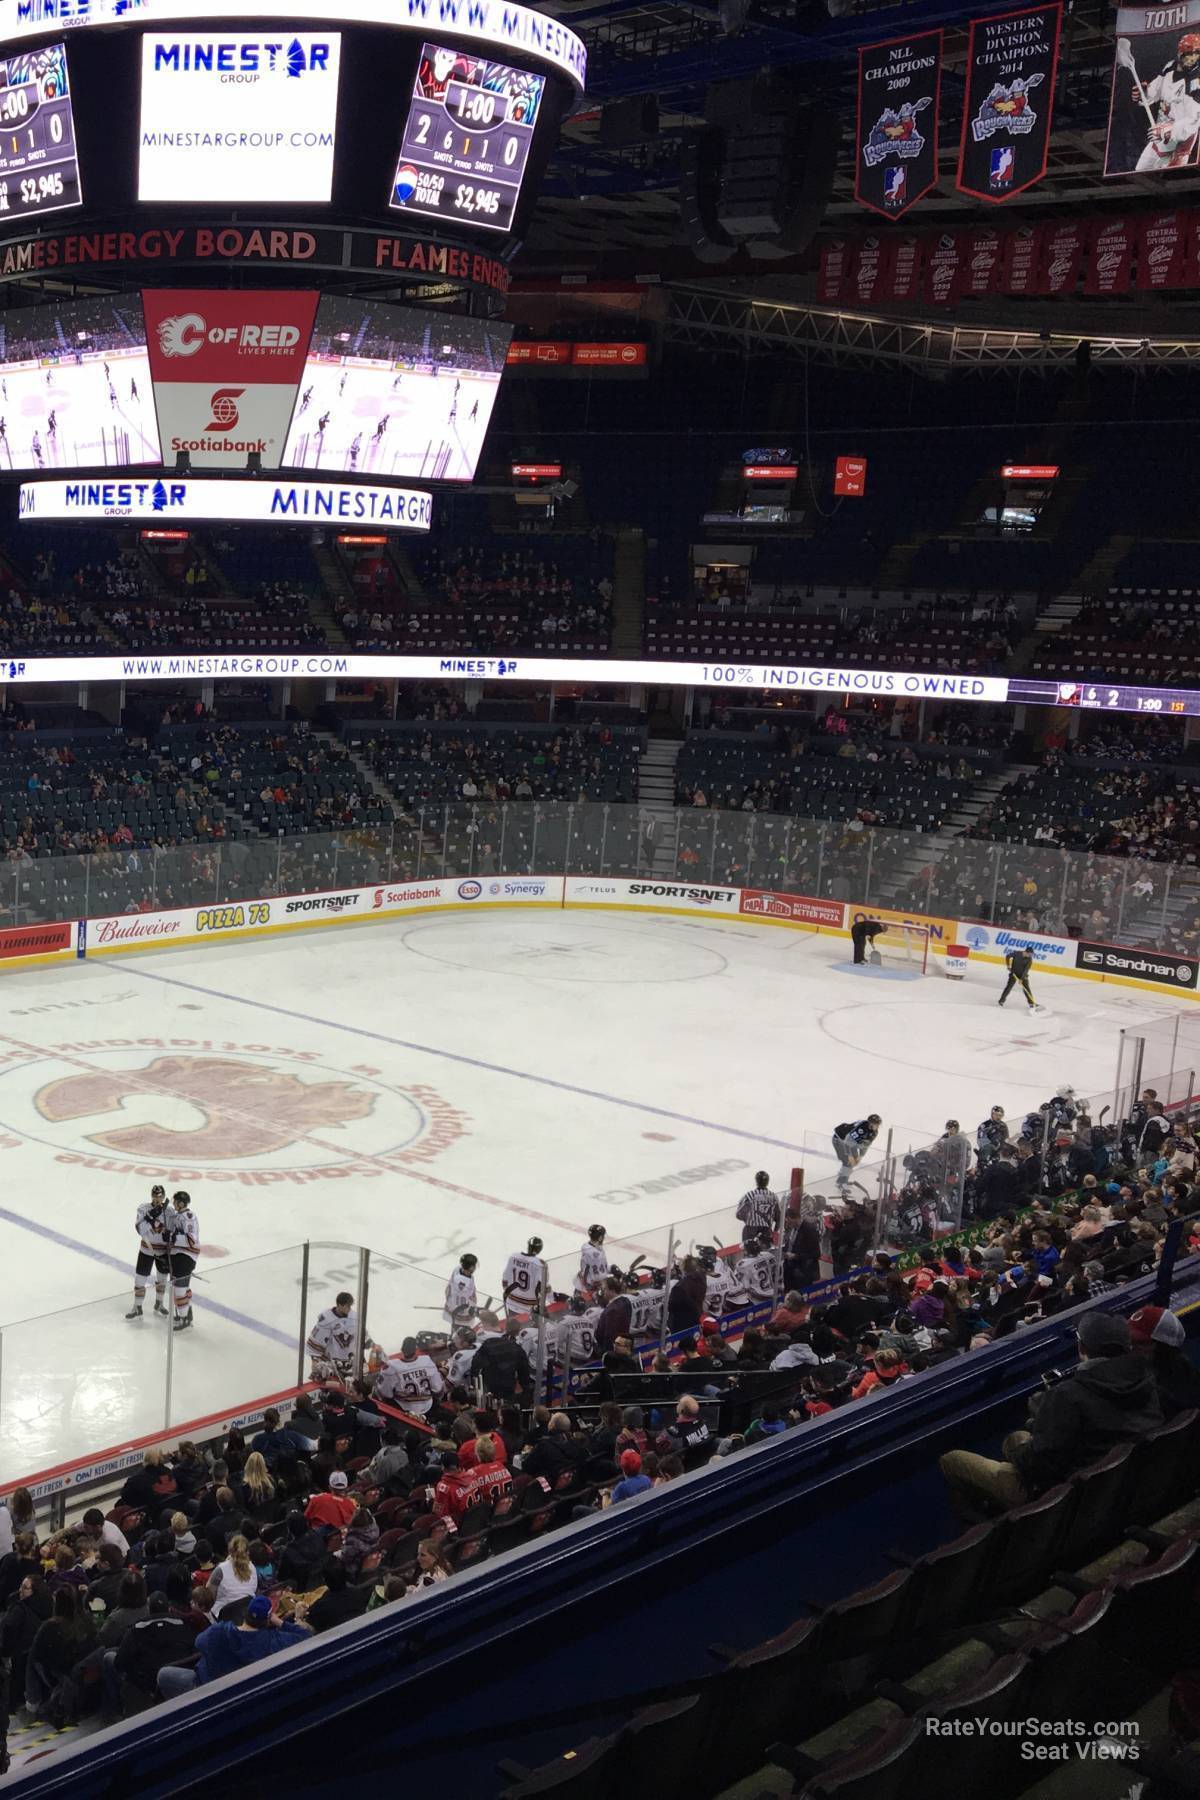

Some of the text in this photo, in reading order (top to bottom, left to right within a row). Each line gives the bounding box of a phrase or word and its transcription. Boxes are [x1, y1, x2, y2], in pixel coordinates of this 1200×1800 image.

[985, 16, 1045, 36] WESTERN
[1145, 6, 1187, 29] TOTH
[985, 30, 1043, 50] DIVISION
[154, 38, 330, 77] MINESTAR
[888, 47, 914, 61] NLL
[975, 42, 1050, 66] CHAMPIONS
[220, 74, 260, 83] GROUP
[864, 56, 936, 81] CHAMPIONS
[999, 61, 1024, 75] 2014
[886, 77, 911, 91] 2009
[457, 89, 495, 123] 1:00
[50, 113, 63, 143] 0
[142, 132, 333, 147] MINESTARGROUP.COM
[414, 114, 518, 165] 2 6 1 1 0
[27, 151, 47, 161] SHOTS
[433, 150, 453, 163] SHOTS
[474, 161, 493, 172] SHOTS
[20, 172, 64, 203] $2,945
[415, 187, 440, 206] TOTAL
[417, 172, 501, 214] 50/50 $2,945
[64, 230, 184, 263] ENERGY
[194, 229, 317, 260] BOARD
[375, 238, 469, 278] FLAMES
[208, 325, 301, 347] OF RED
[237, 347, 296, 356] LIVES HERE
[171, 437, 267, 452] Scotiabank
[65, 481, 187, 510] MINESTAR
[104, 507, 133, 516] GROUP
[122, 658, 348, 674] WWW.MINESTARGROUP.COM
[702, 666, 755, 683] 100%
[762, 669, 895, 690] INDIGENOUS
[904, 676, 986, 695] OWNED
[1088, 688, 1097, 699] 6
[1107, 689, 1119, 706] 2
[1137, 697, 1163, 710] 1:00
[1170, 702, 1186, 712] 1ST
[460, 885, 479, 894] Esso
[505, 883, 546, 895] Synergy
[629, 883, 736, 902] SPORTSNET
[96, 919, 180, 942] Budweiser
[196, 906, 244, 931] PIZZA
[249, 903, 270, 924] 73
[286, 895, 360, 913] SPORTSNET
[387, 887, 441, 903] Scotiabank
[744, 900, 764, 912] PAPA
[793, 908, 818, 919] BETTER
[3, 931, 66, 950] WARRIOR
[995, 932, 1066, 955] Wawanesa
[1106, 954, 1175, 976] Sandman
[512, 1269, 530, 1292] 19
[582, 1331, 593, 1352] 8
[402, 1370, 428, 1382] PETERS
[94, 1451, 144, 1476] KEEPING FRESH
[43, 1480, 64, 1494] FRESH
